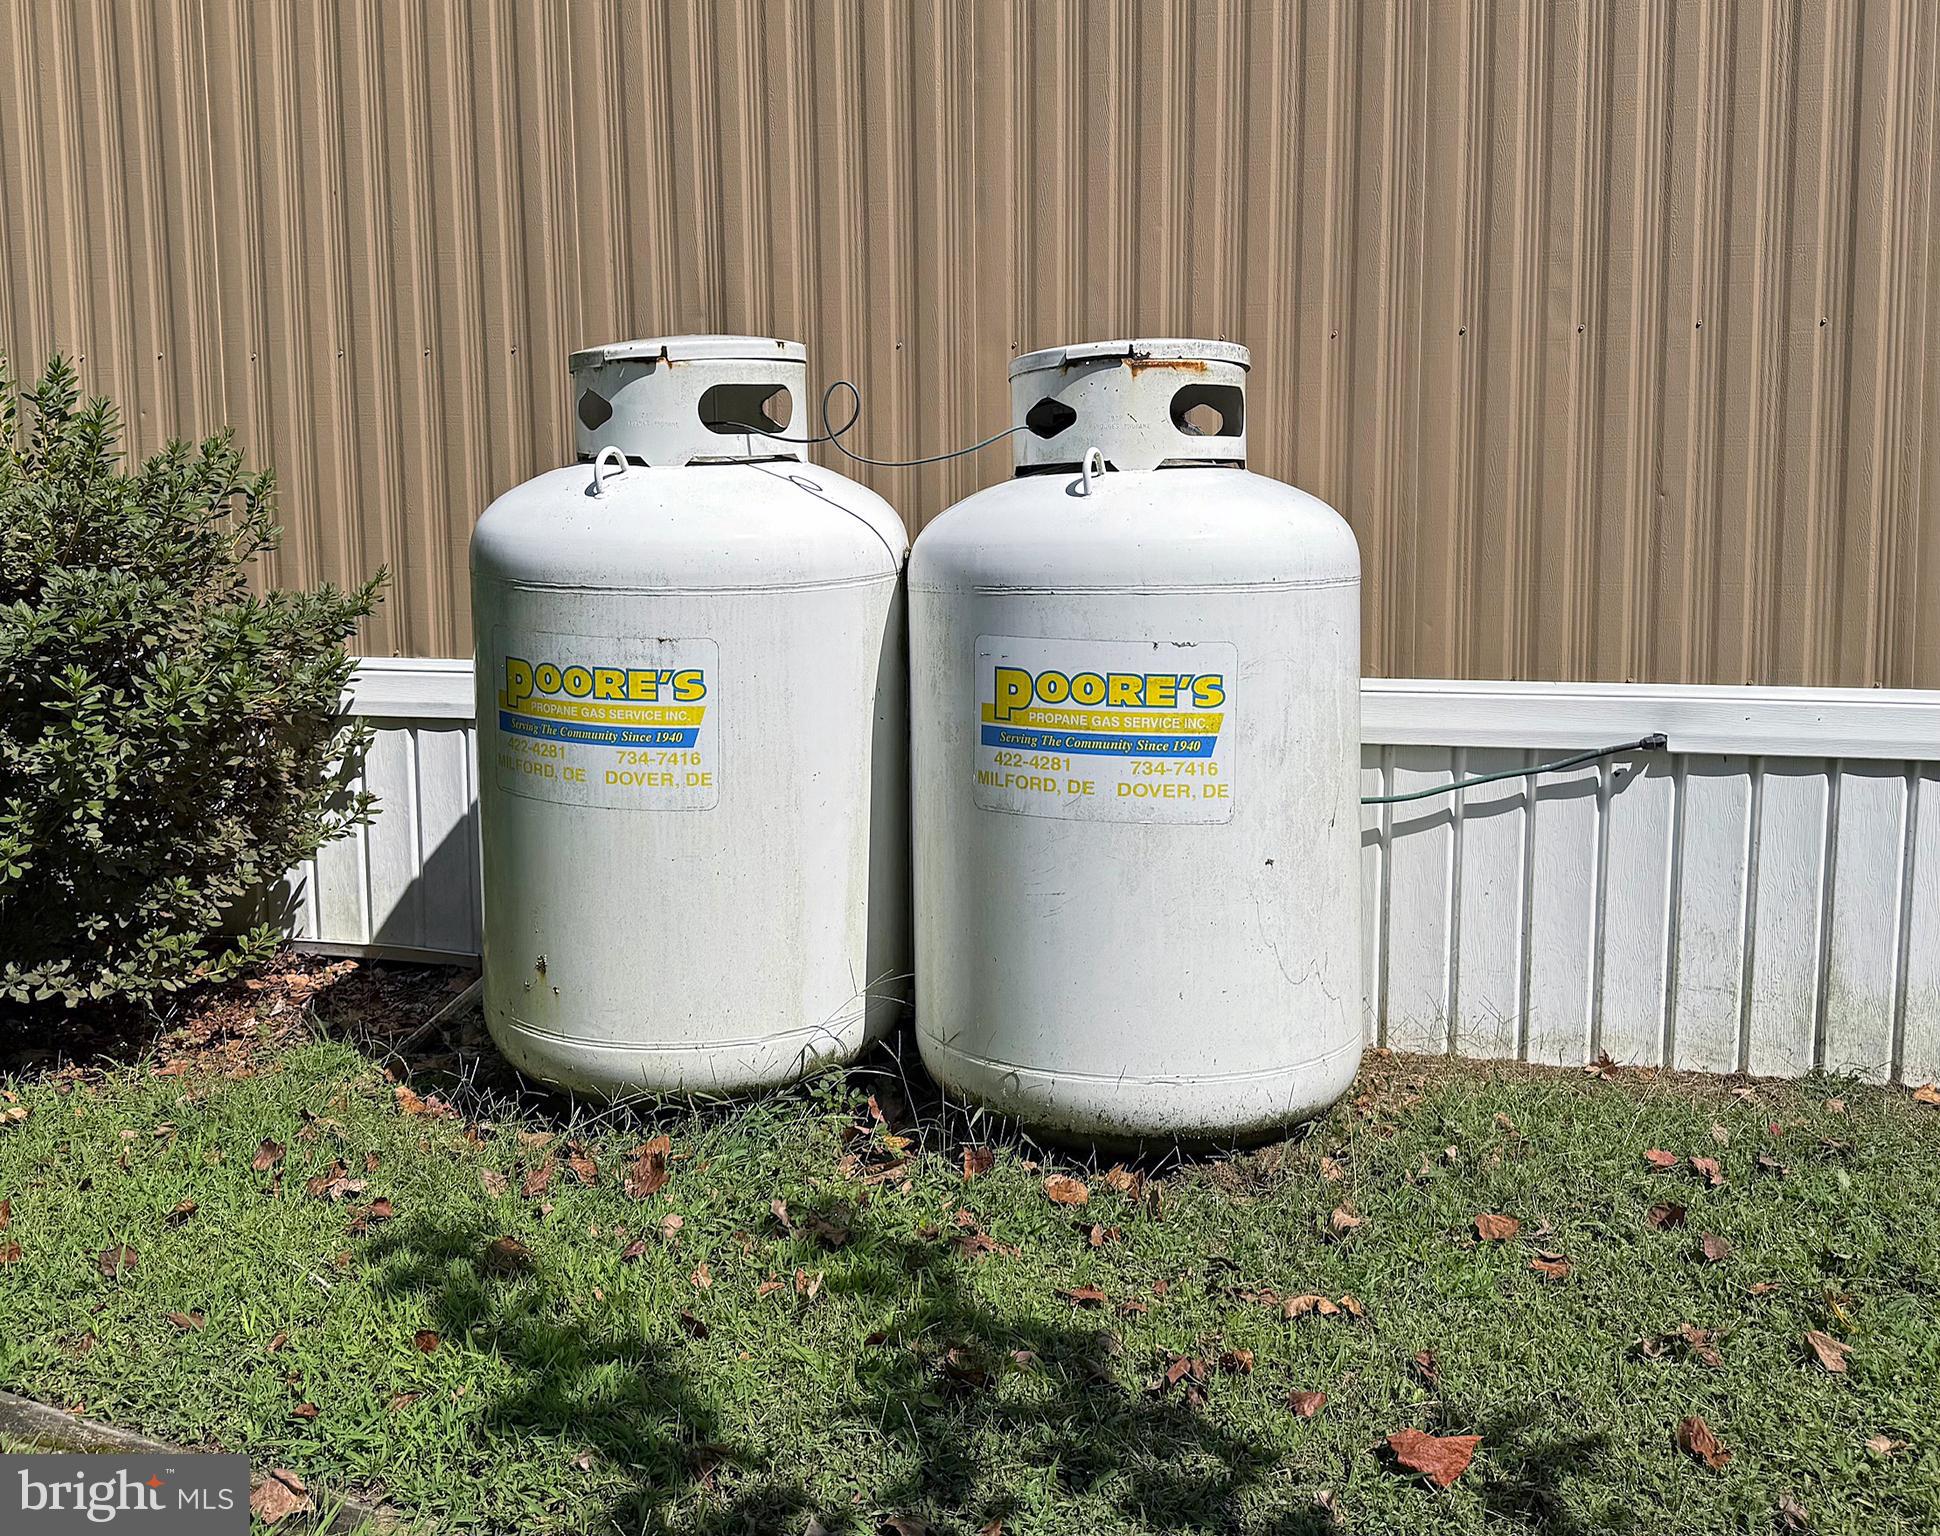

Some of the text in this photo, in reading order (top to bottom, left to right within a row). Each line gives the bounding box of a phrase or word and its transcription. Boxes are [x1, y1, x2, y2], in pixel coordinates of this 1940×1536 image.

[506, 656, 707, 708] POORE'S
[994, 666, 1226, 721] POORE'S
[531, 701, 691, 721] PROPANE GAS SERVICE INC.
[1028, 712, 1210, 729] PROPANE GAS SERVICE INC.
[511, 718, 684, 744] Serving The Community Since 1940
[507, 736, 566, 759] 422-4281
[999, 731, 1201, 753] Serving The Community Since 1940
[497, 753, 588, 782] MILFORD, DE
[616, 751, 701, 766] 734-7416
[993, 751, 1071, 771] 422-4281
[1130, 760, 1219, 777] 734-7416
[605, 771, 712, 789] DOVER, DE
[977, 770, 1095, 797] MILFORD, DE
[1117, 783, 1230, 800] DOVER, DE
